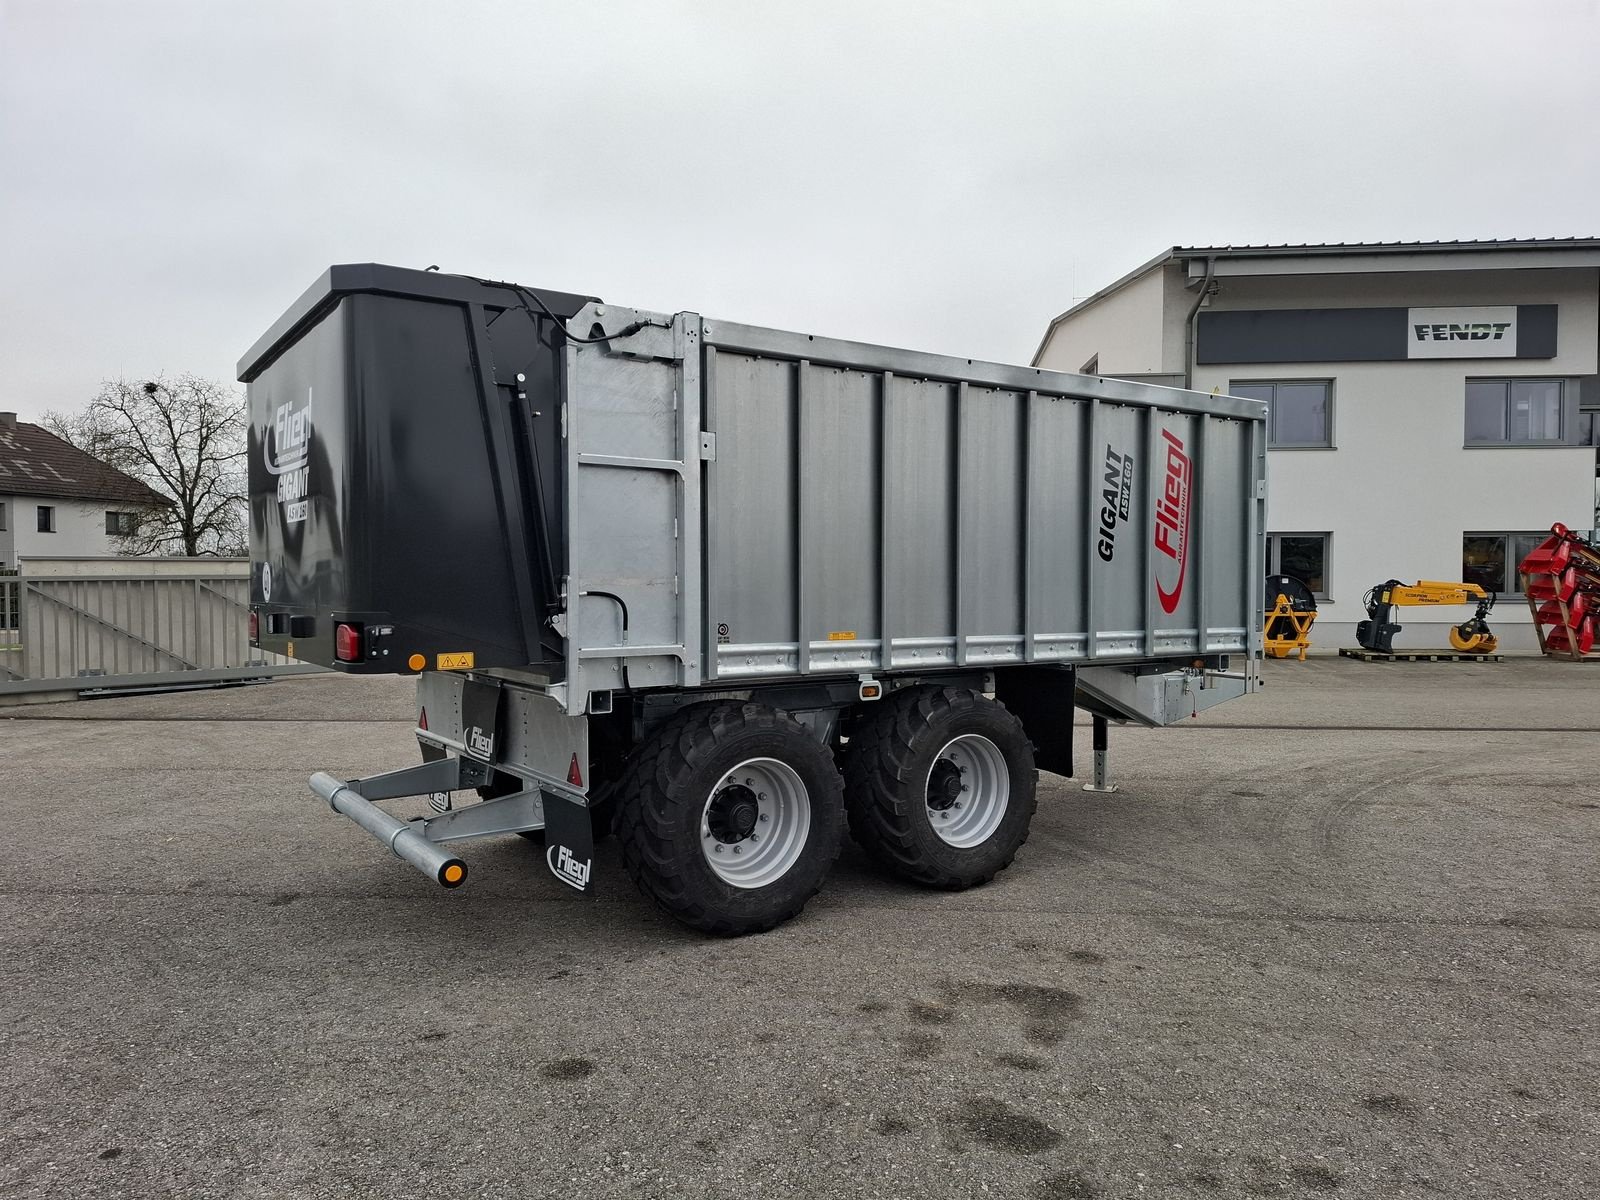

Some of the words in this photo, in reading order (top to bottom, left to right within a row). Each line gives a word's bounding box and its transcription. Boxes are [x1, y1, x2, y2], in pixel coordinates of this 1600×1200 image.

[1414, 323, 1511, 341] FENDT
[275, 387, 312, 454] Fliegl
[278, 466, 309, 504] GIGANT
[1123, 460, 1132, 485] 160
[1098, 443, 1122, 563] GIGANT
[1120, 485, 1130, 519] ASW
[1154, 427, 1188, 560] Fliegl
[470, 726, 494, 757] Fliegl
[557, 845, 591, 887] Fliegl
